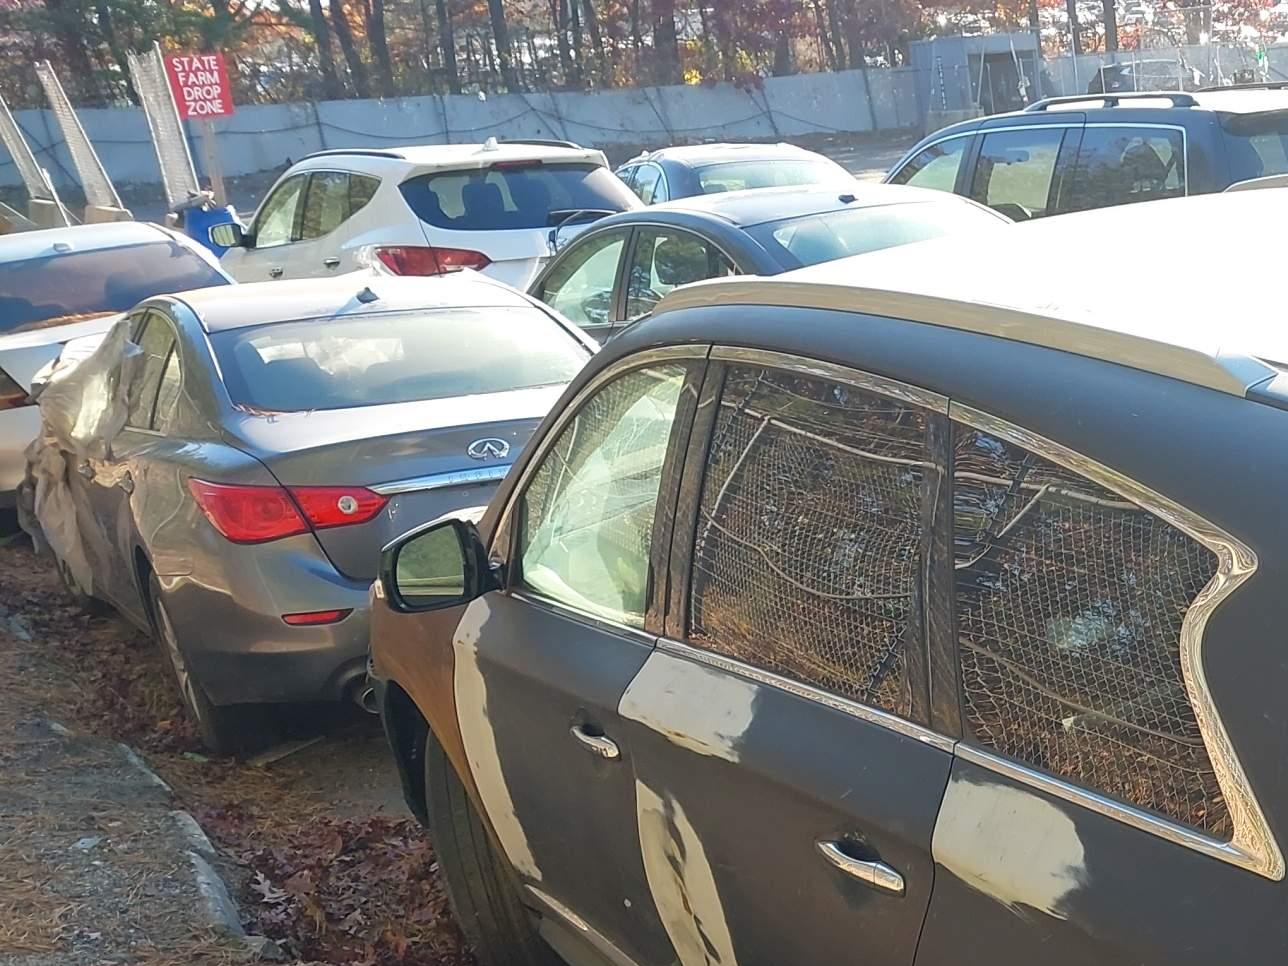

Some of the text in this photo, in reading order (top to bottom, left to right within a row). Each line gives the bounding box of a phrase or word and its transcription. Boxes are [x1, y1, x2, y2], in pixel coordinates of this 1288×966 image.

[172, 55, 219, 72] STATE
[177, 71, 220, 86] FARM
[183, 85, 222, 101] DROP
[186, 99, 225, 116] ZONE
